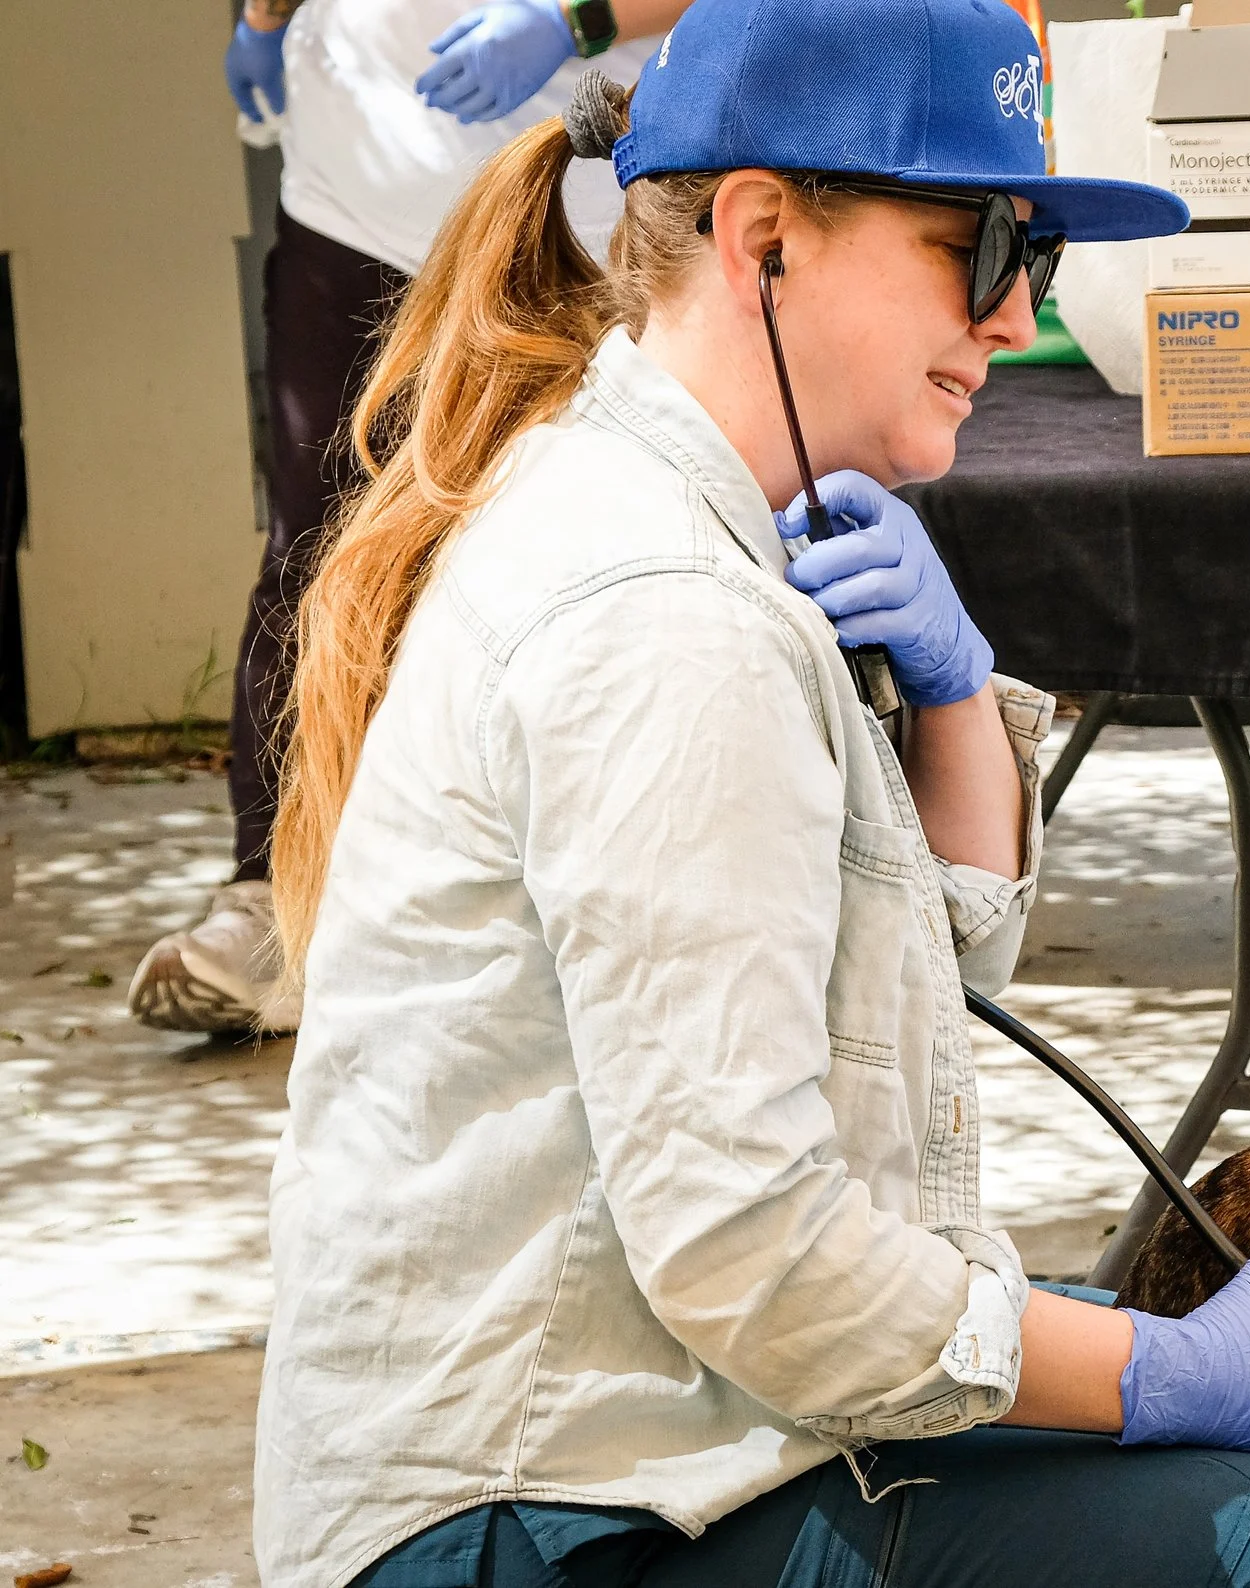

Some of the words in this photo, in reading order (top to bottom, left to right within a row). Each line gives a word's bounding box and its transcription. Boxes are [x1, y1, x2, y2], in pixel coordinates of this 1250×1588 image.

[1180, 178, 1194, 186] mL
[1198, 176, 1242, 186] SYRINGE
[1158, 310, 1240, 331] NIPRO
[1158, 335, 1216, 347] SYRINGE
